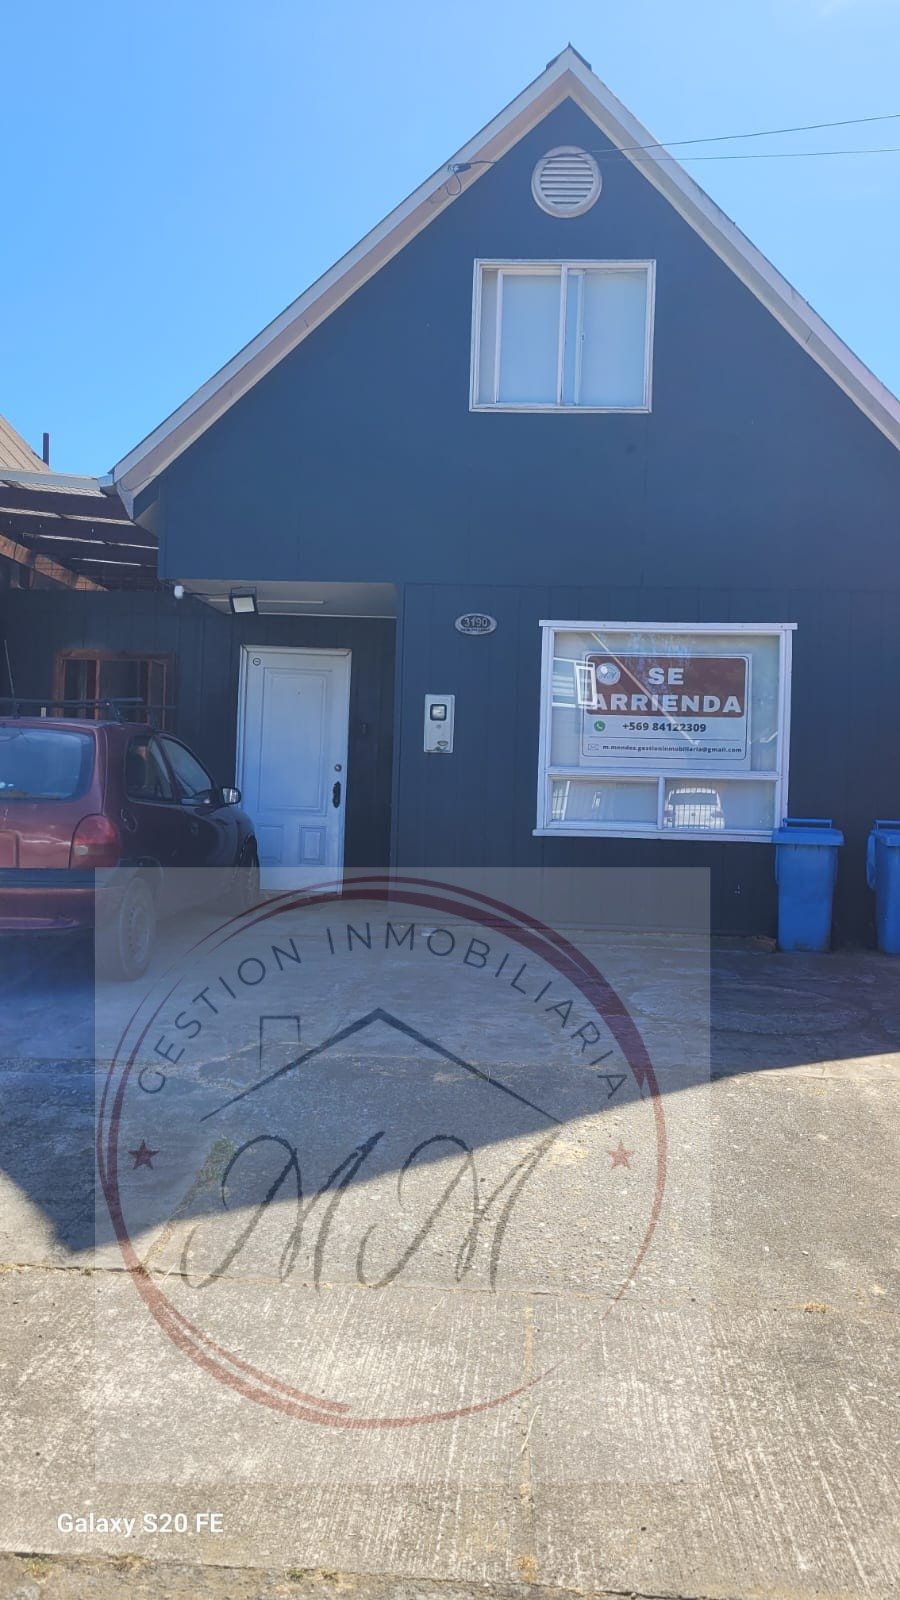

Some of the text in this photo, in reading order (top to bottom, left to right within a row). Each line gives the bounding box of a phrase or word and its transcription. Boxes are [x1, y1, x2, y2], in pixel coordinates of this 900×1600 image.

[463, 616, 489, 627] 3190
[648, 667, 684, 685] SE
[595, 693, 742, 713] ARRIENDA
[622, 722, 707, 732] +569 84122309
